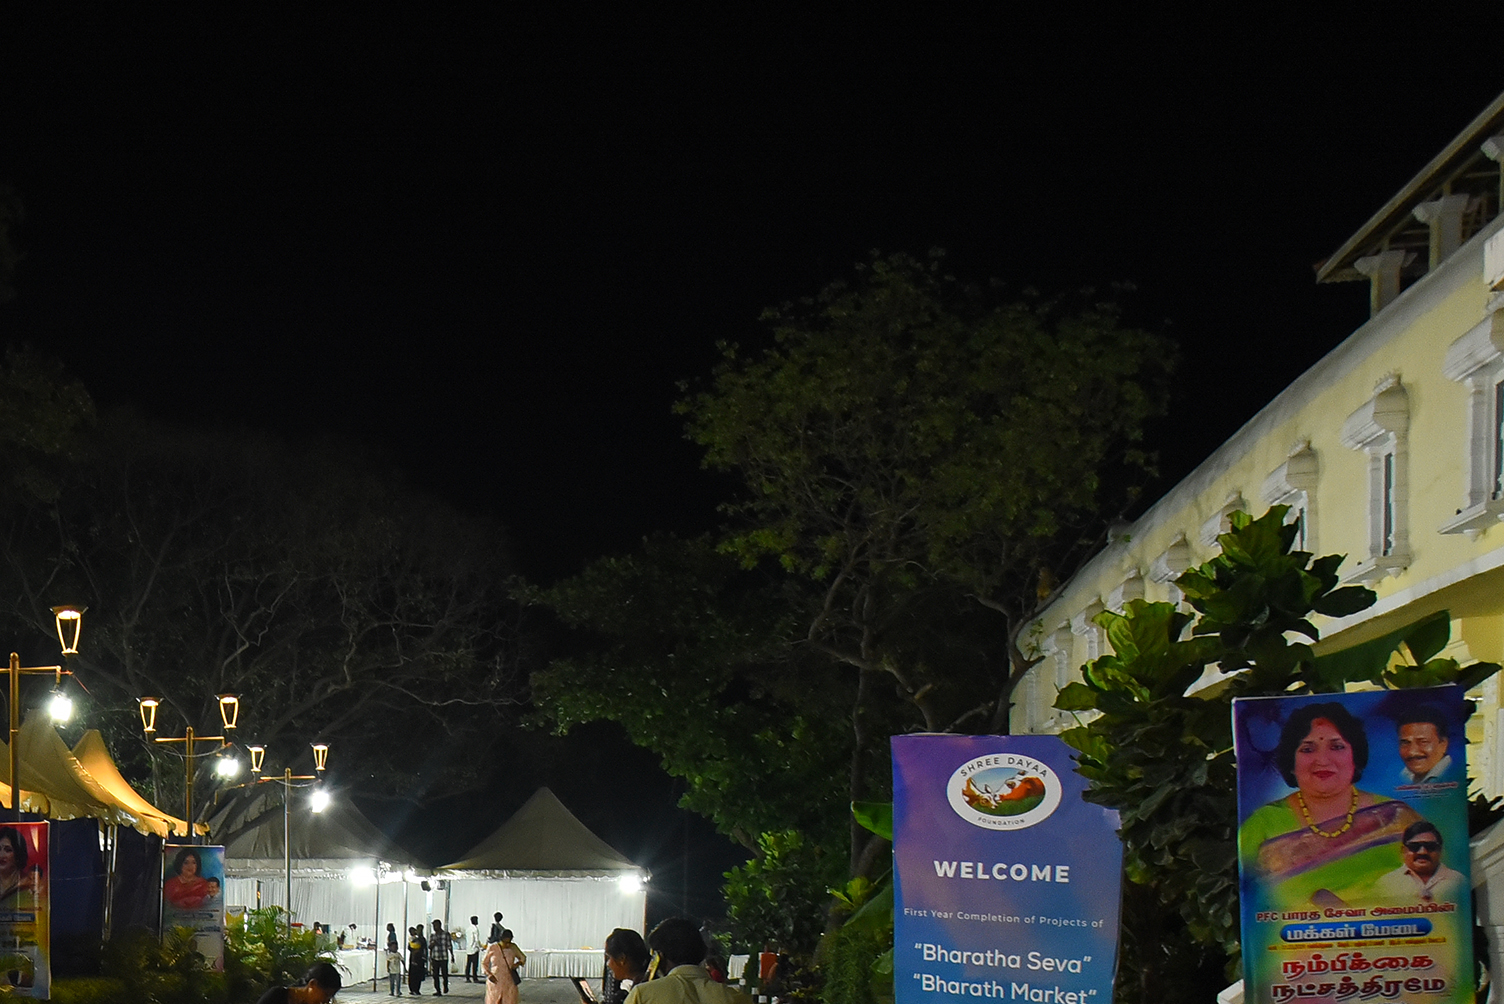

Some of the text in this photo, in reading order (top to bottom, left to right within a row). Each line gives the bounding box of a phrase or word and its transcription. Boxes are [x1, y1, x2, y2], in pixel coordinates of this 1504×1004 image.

[960, 756, 1048, 778] SHREE DAYAA
[977, 816, 1025, 827] FOUNDATION
[933, 860, 1070, 884] WELCOME
[903, 907, 1104, 929] First Year Completion of Projects of
[1256, 912, 1278, 922] PFC
[1282, 910, 1321, 921] பாரத
[1324, 907, 1367, 919] சேவா
[1287, 923, 1426, 941] மக்கள் மேடை
[1283, 952, 1435, 980] நம்பிக்கை
[1272, 975, 1446, 1004] நட்சத்திரமே
